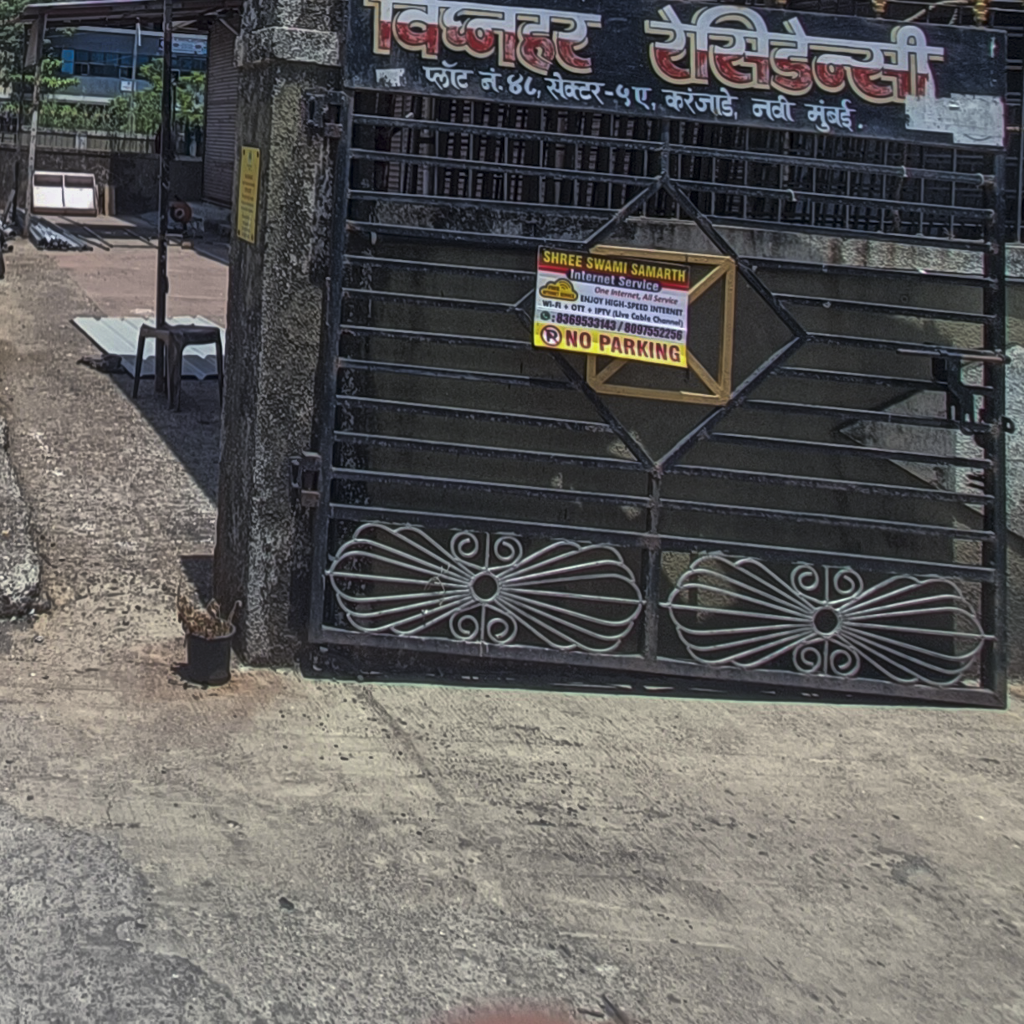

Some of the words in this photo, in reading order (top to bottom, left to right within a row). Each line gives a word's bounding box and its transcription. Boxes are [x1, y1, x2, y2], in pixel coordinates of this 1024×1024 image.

[751, 94, 797, 123] नवी
[543, 250, 582, 268] SHREE
[586, 256, 628, 275] SWAMI
[631, 263, 686, 283] SAMARTH
[570, 269, 616, 286] Internet
[618, 276, 660, 292] Service
[580, 295, 604, 305] ENJOY
[604, 298, 649, 313] HIGH-SPEED
[650, 305, 684, 317] INTERNET
[594, 286, 610, 296] One
[642, 293, 653, 301] All
[653, 295, 679, 306] Service
[571, 304, 586, 313] OTT
[594, 307, 612, 317] IPTV
[631, 312, 652, 323] Cable
[624, 322, 683, 341] 8097552256
[565, 329, 592, 350] NO
[599, 334, 682, 363] PARKING
